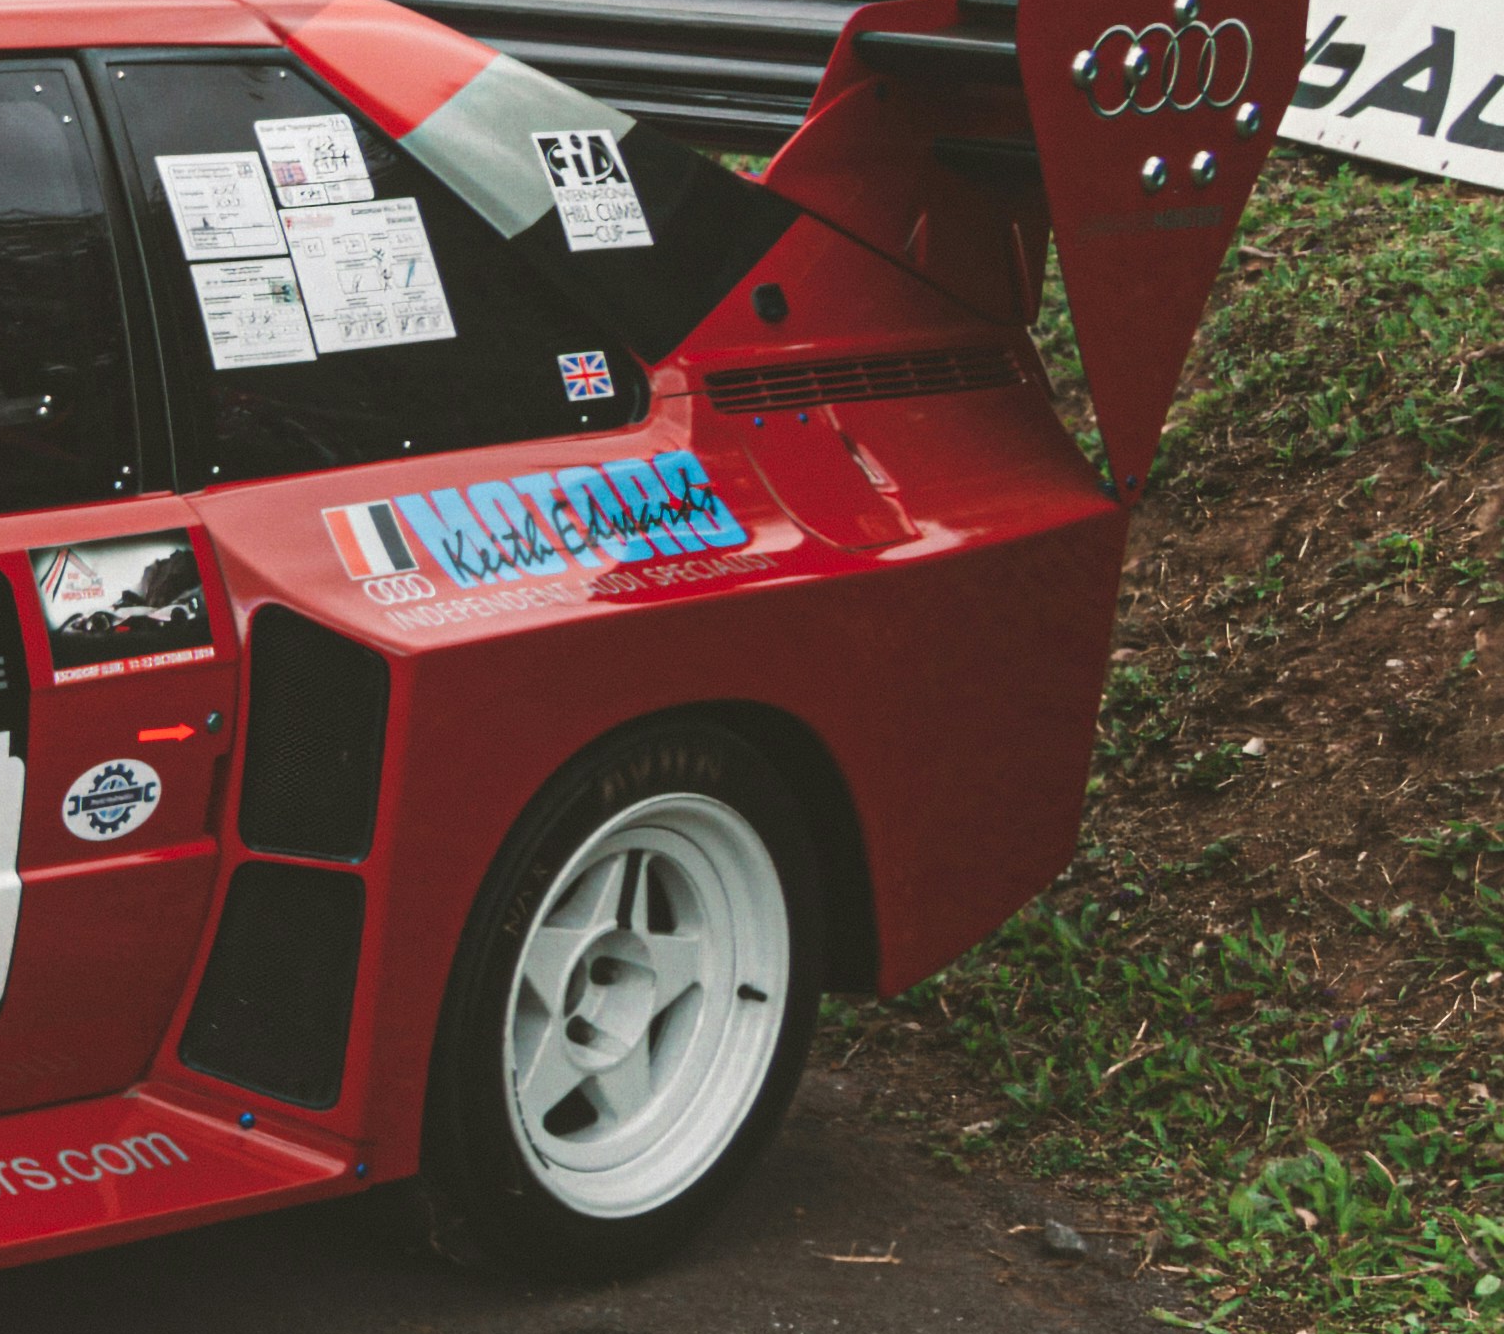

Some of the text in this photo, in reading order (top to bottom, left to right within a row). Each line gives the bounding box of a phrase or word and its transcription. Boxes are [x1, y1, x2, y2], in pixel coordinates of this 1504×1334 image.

[393, 449, 748, 590] MOTORS
[441, 474, 718, 582] Keith Edwards
[383, 550, 779, 632] INDEPENDENT AUDI SPECIALIST
